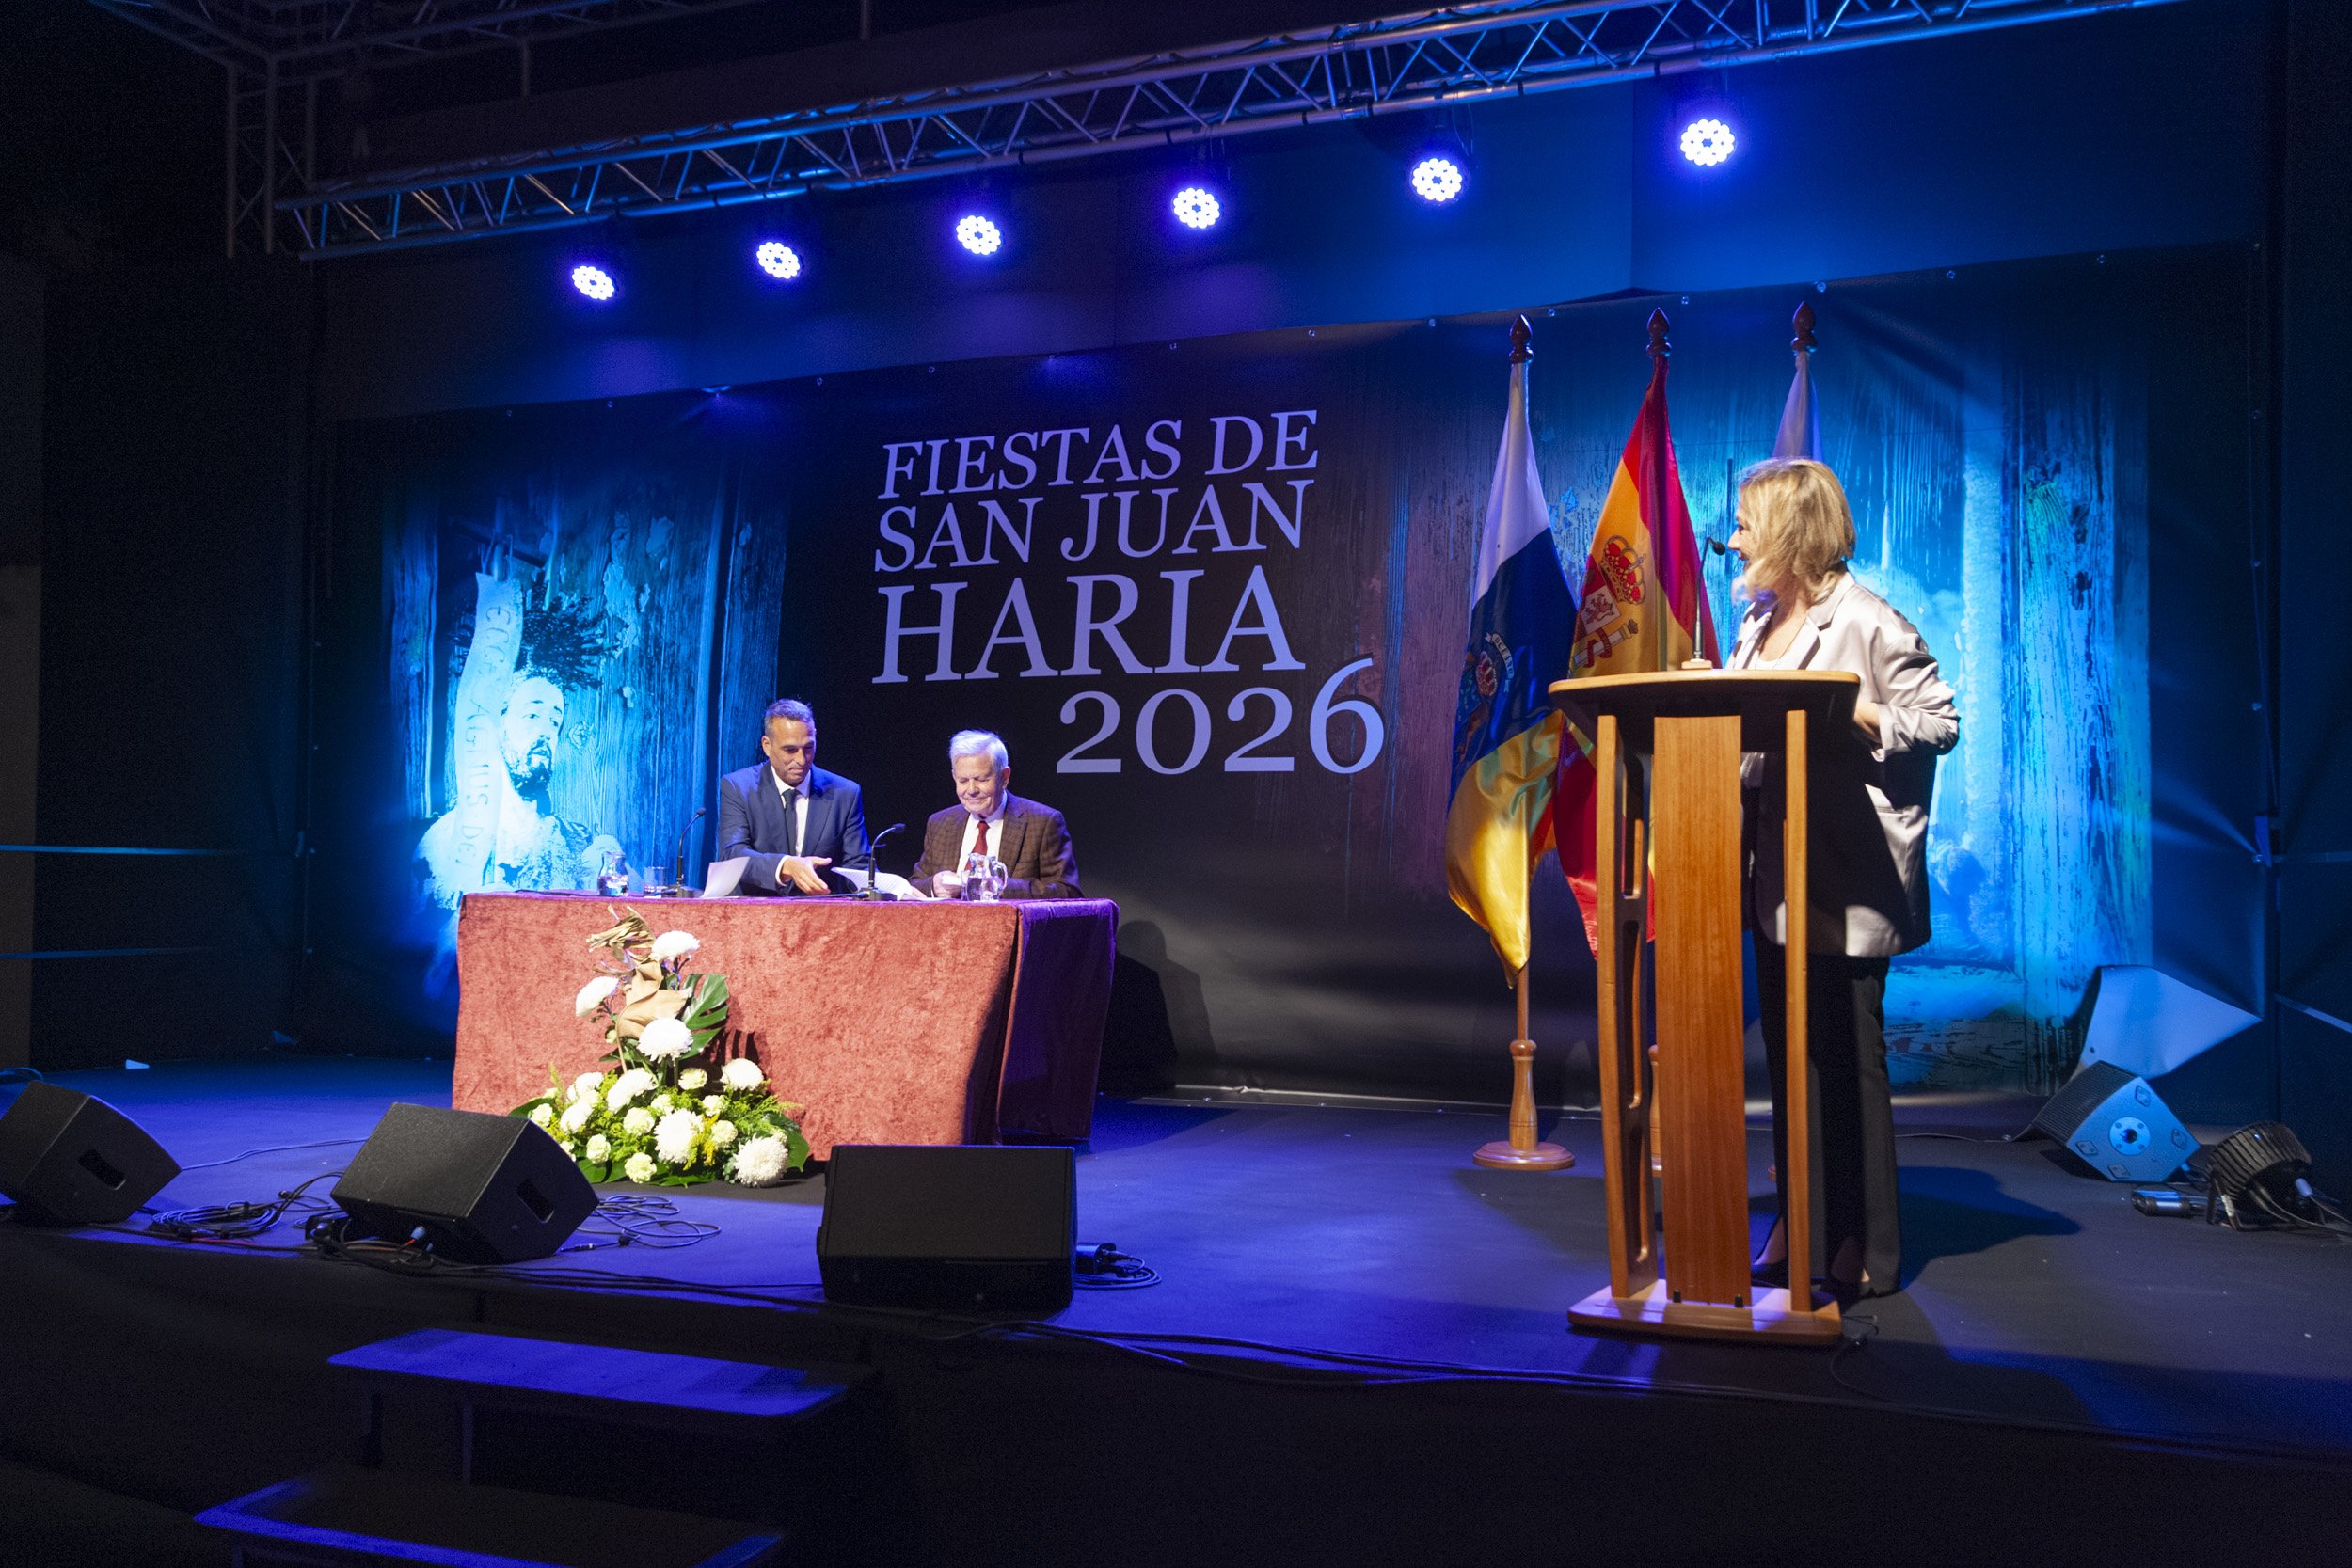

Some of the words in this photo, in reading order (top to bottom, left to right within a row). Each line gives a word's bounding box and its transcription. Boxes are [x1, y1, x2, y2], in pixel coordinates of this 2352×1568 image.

[877, 420, 1182, 499] FIESTAS
[1204, 409, 1319, 476] DE
[874, 497, 1044, 572] SAN
[1060, 479, 1315, 562] JUAN
[871, 564, 1307, 684] HARIA
[1056, 657, 1385, 775] 2026
